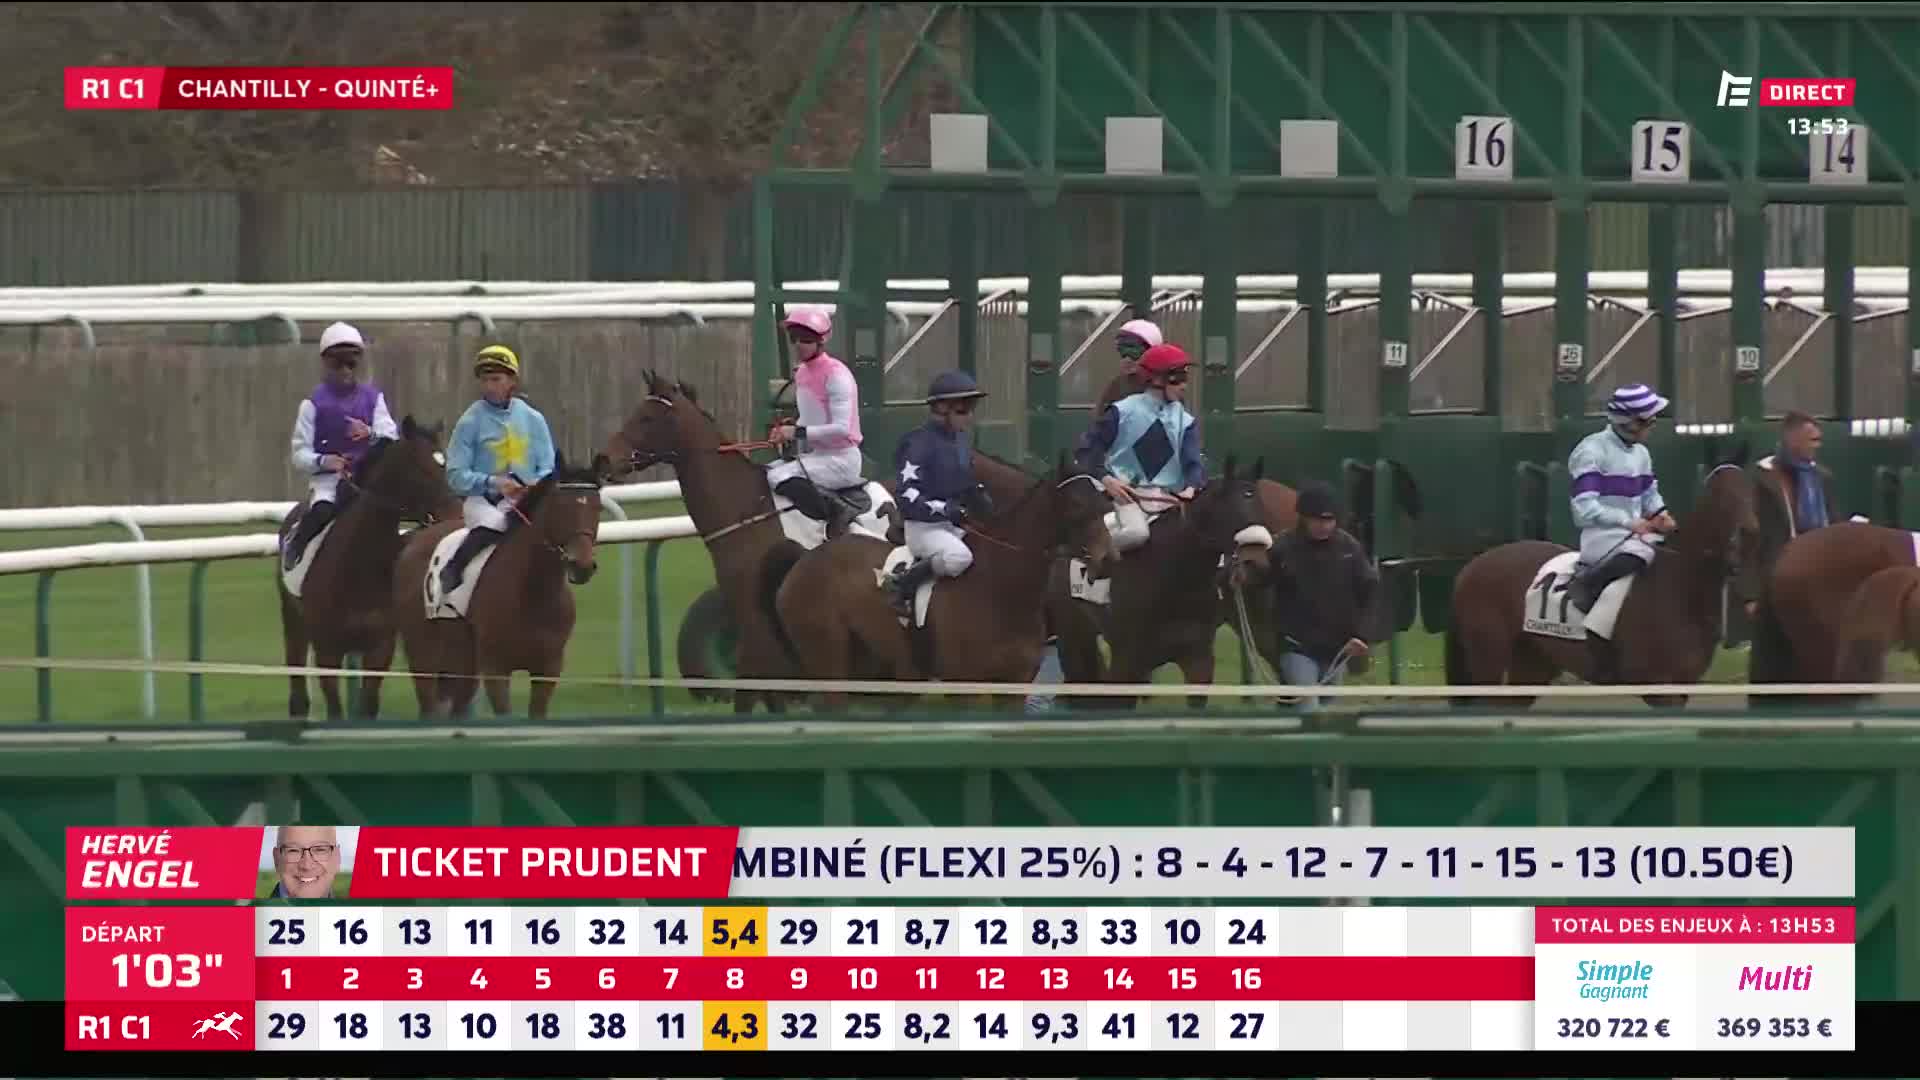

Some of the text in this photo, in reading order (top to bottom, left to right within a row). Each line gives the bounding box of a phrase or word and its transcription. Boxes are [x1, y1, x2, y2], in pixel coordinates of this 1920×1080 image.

[1466, 119, 1506, 168] 16
[1640, 125, 1682, 172] 15
[1823, 127, 1856, 173] 14
